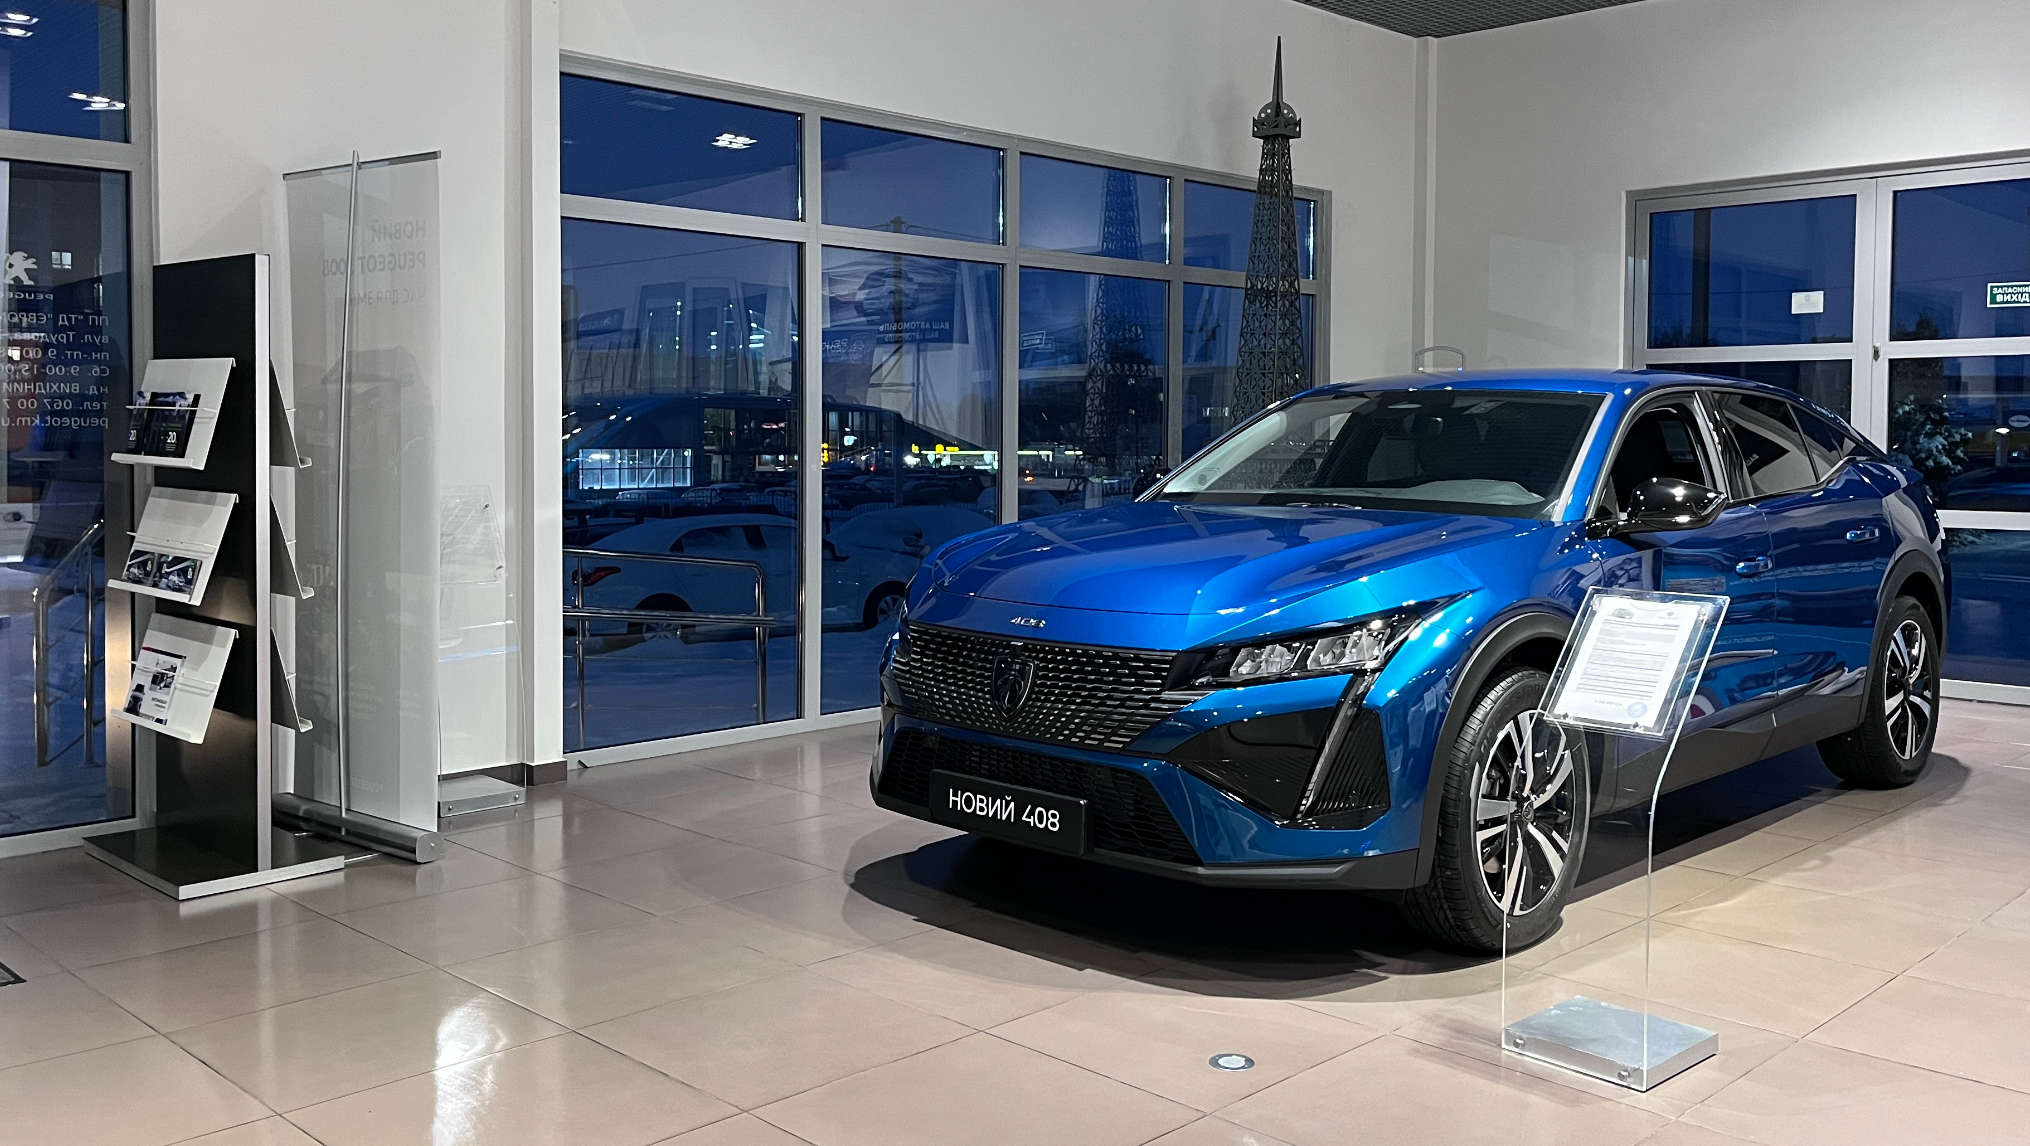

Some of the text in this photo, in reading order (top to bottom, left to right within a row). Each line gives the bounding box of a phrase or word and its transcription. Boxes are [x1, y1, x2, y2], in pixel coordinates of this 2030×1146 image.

[1996, 293, 2029, 303] ВИХІД
[949, 788, 1060, 832] НОВИЙ 408
